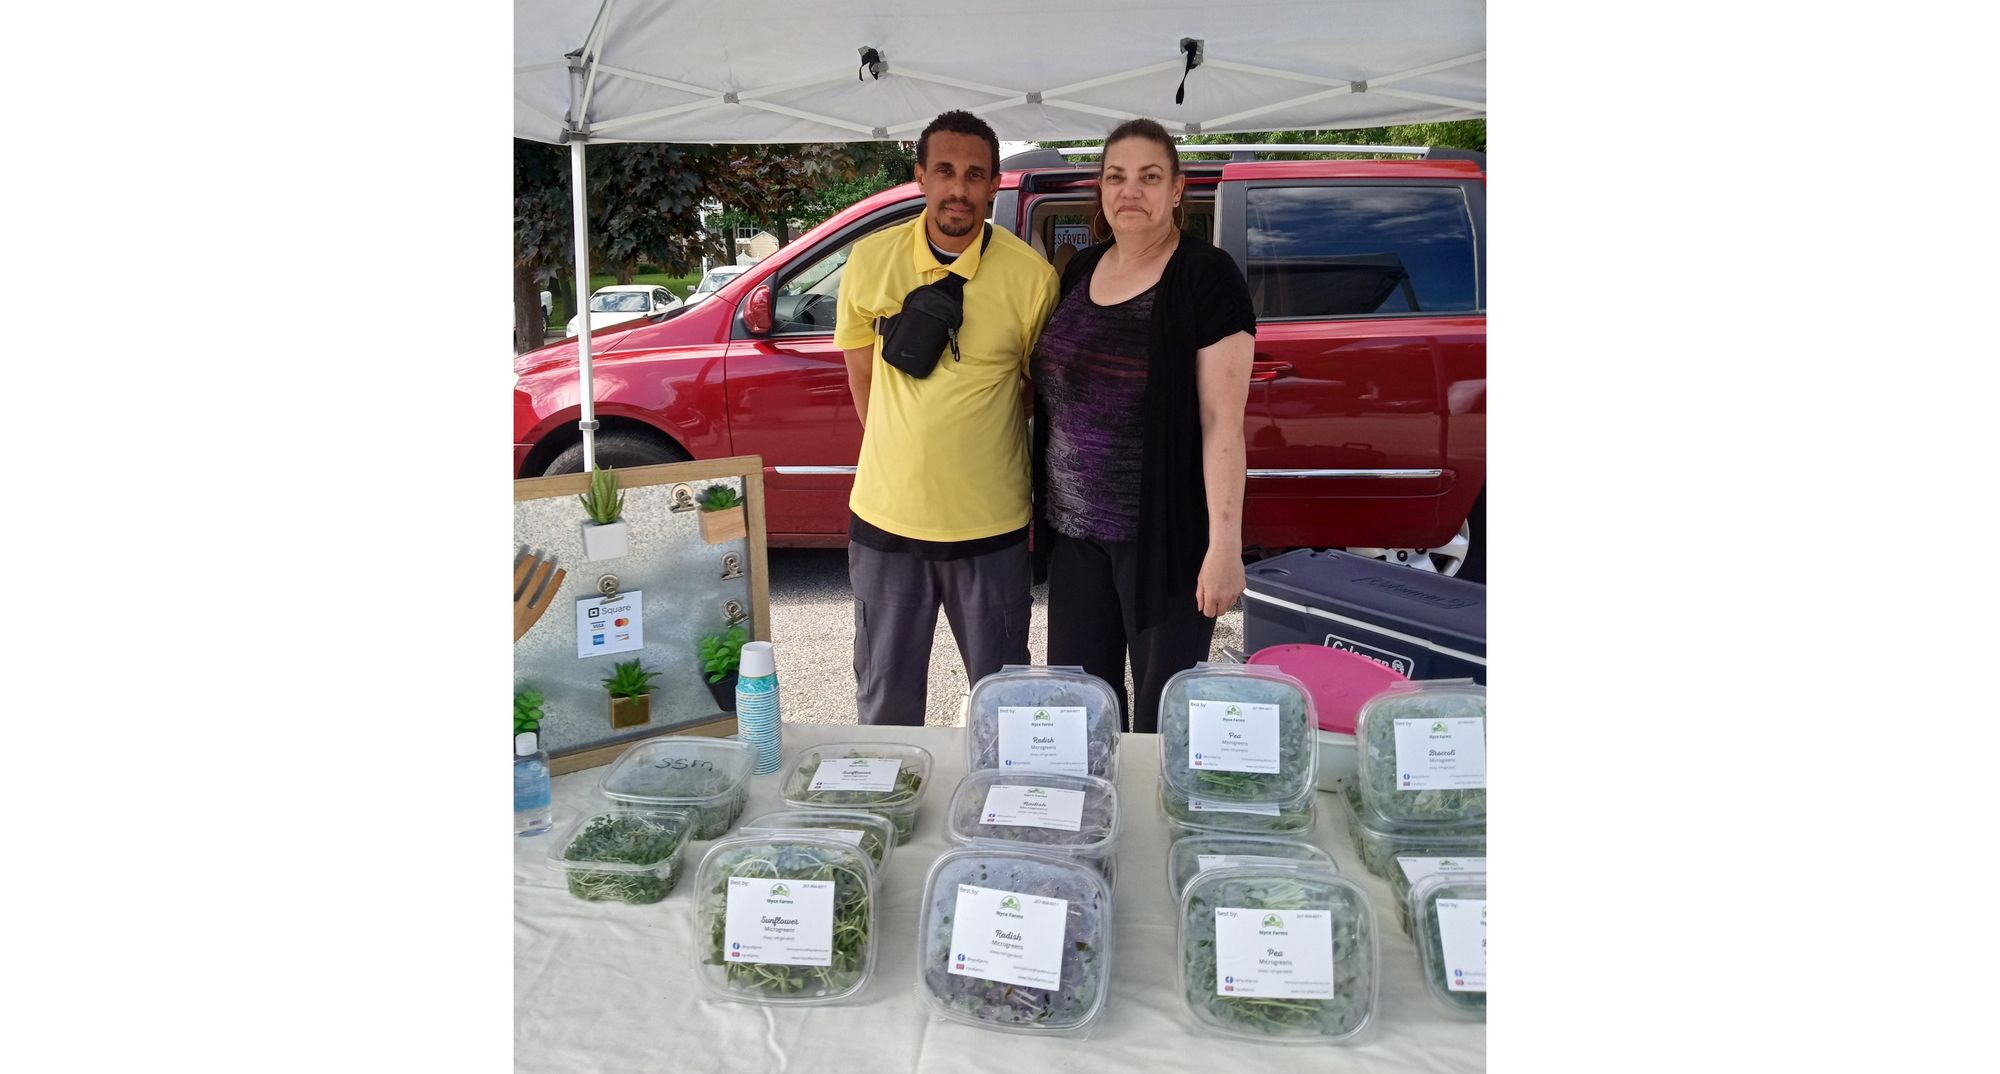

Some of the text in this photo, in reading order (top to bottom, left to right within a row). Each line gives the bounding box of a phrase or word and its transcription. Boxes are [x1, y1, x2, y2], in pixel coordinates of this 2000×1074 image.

[601, 605, 631, 615] Square
[1228, 731, 1241, 739] Pea
[761, 916, 799, 926] Sunflower
[995, 929, 1021, 941] Radish
[991, 940, 1023, 950] Microgreens
[1267, 948, 1283, 957] Pea
